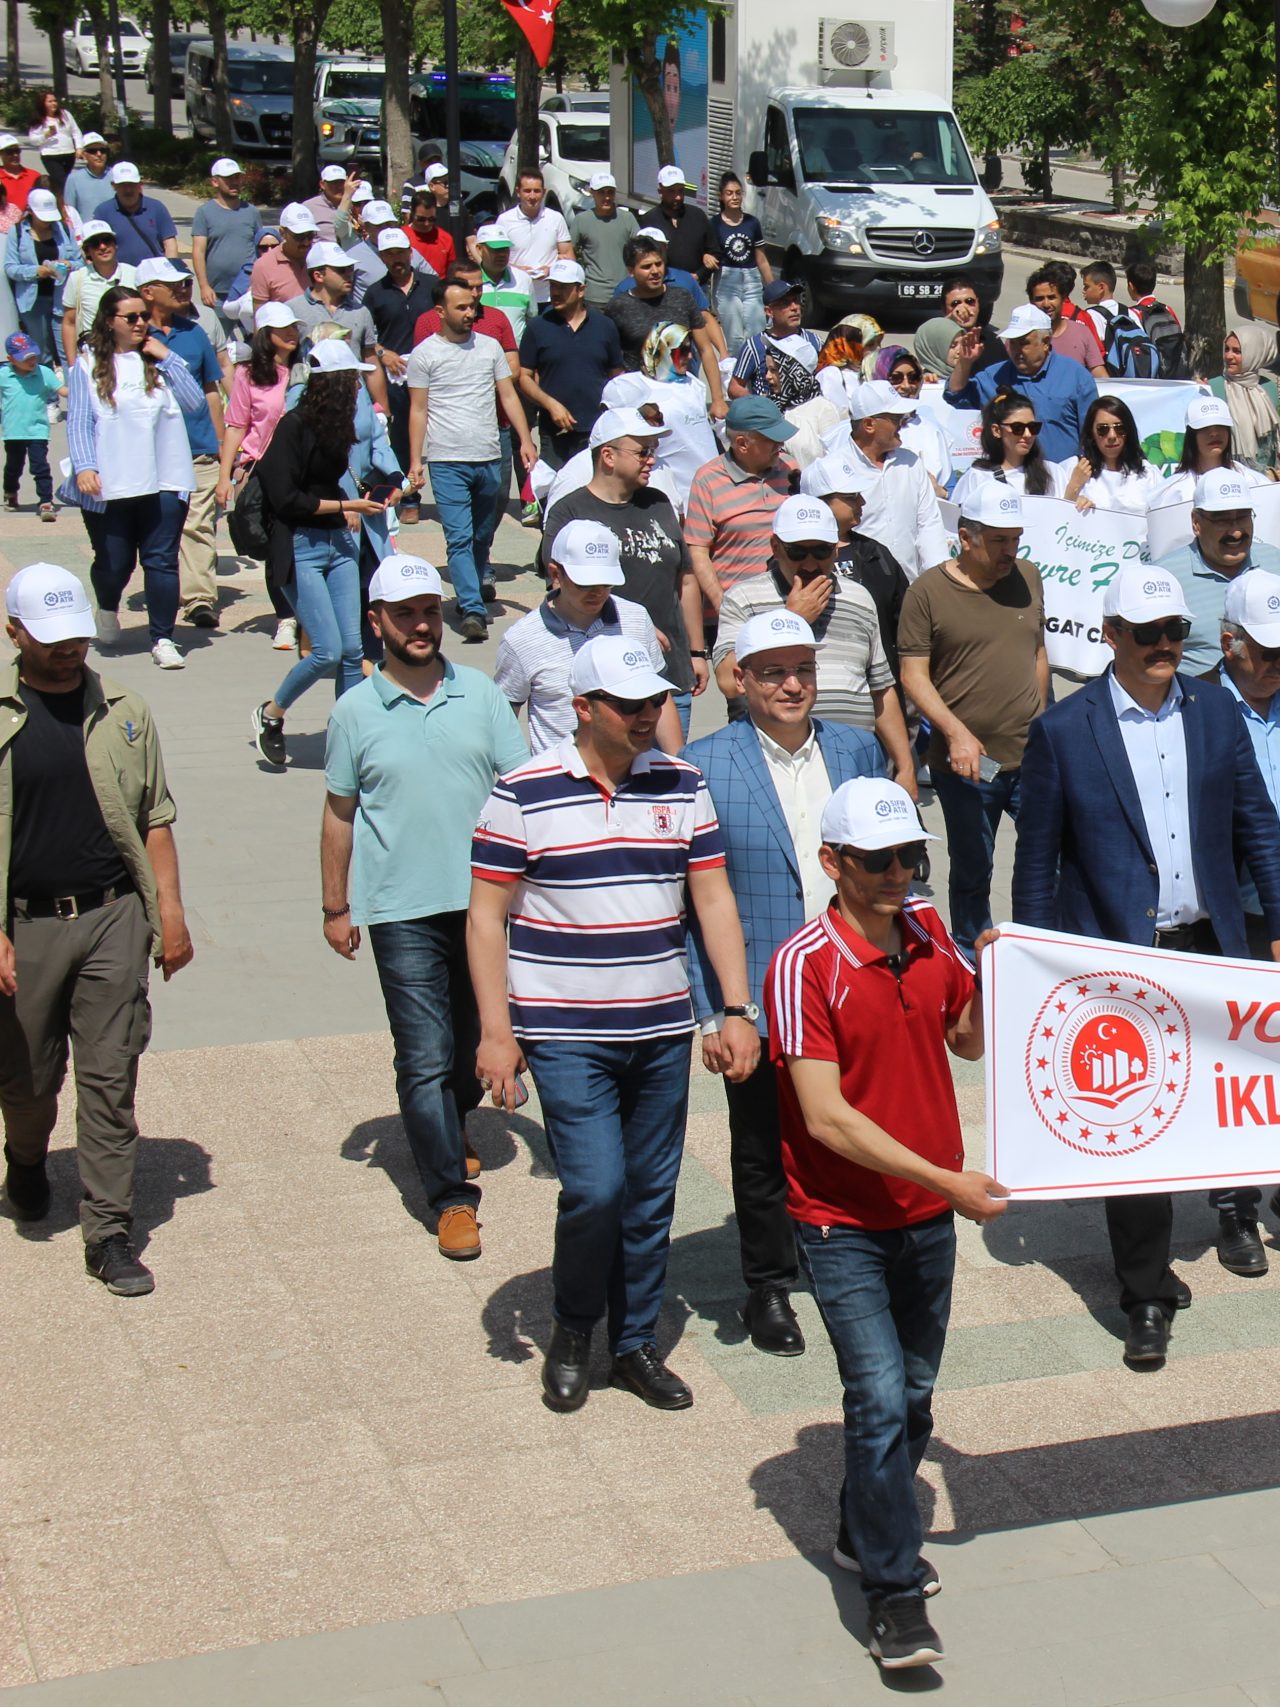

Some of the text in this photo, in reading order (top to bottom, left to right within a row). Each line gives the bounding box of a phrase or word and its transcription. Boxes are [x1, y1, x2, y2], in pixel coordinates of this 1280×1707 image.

[903, 285, 915, 295] 66
[919, 285, 930, 295] SB
[1054, 521, 1151, 563] İçimize Dü
[1045, 617, 1084, 638] GAT
